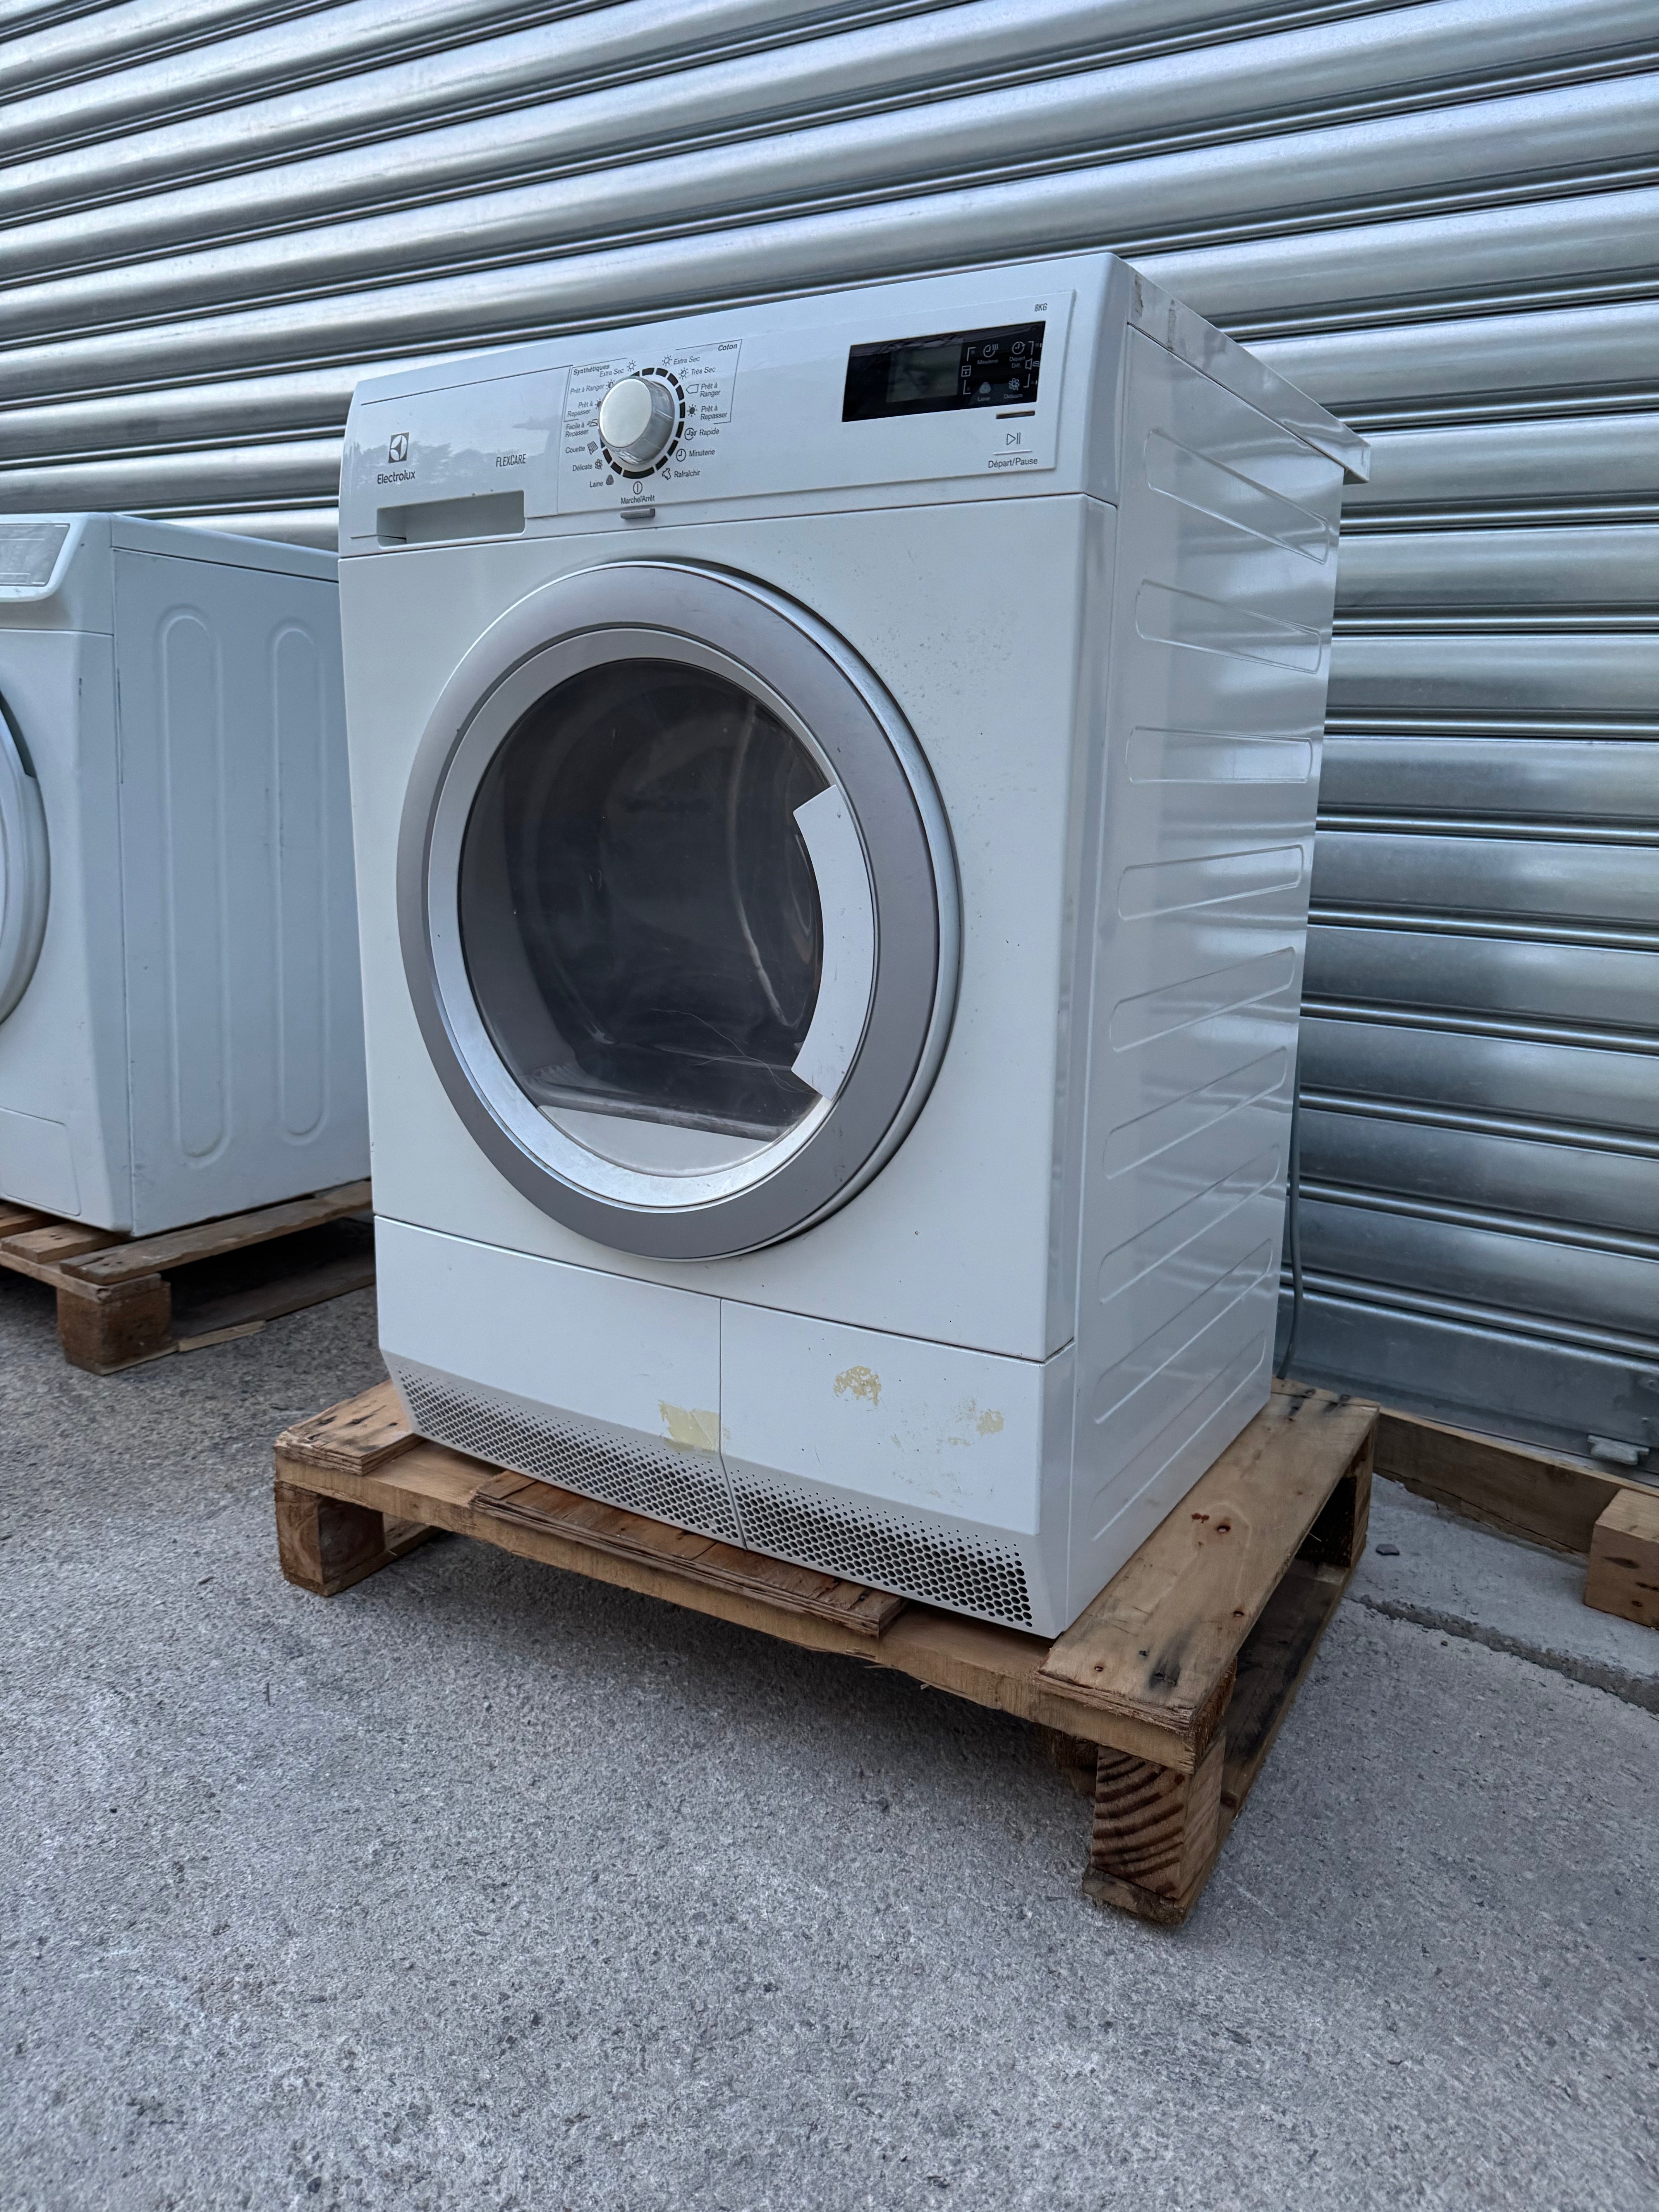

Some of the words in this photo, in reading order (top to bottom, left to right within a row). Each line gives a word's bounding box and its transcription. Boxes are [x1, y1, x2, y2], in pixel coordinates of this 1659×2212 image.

[573, 364, 610, 376] Synthétiques
[586, 384, 605, 392] Ranger
[700, 390, 721, 398] Ranger
[700, 412, 728, 421] Repasser
[699, 428, 720, 437] Rapide
[496, 453, 526, 467] FLEXCARE
[988, 457, 1038, 469] Départ/Pause
[377, 469, 416, 484] Electrolux
[620, 495, 655, 504] Marche/Arrêt
